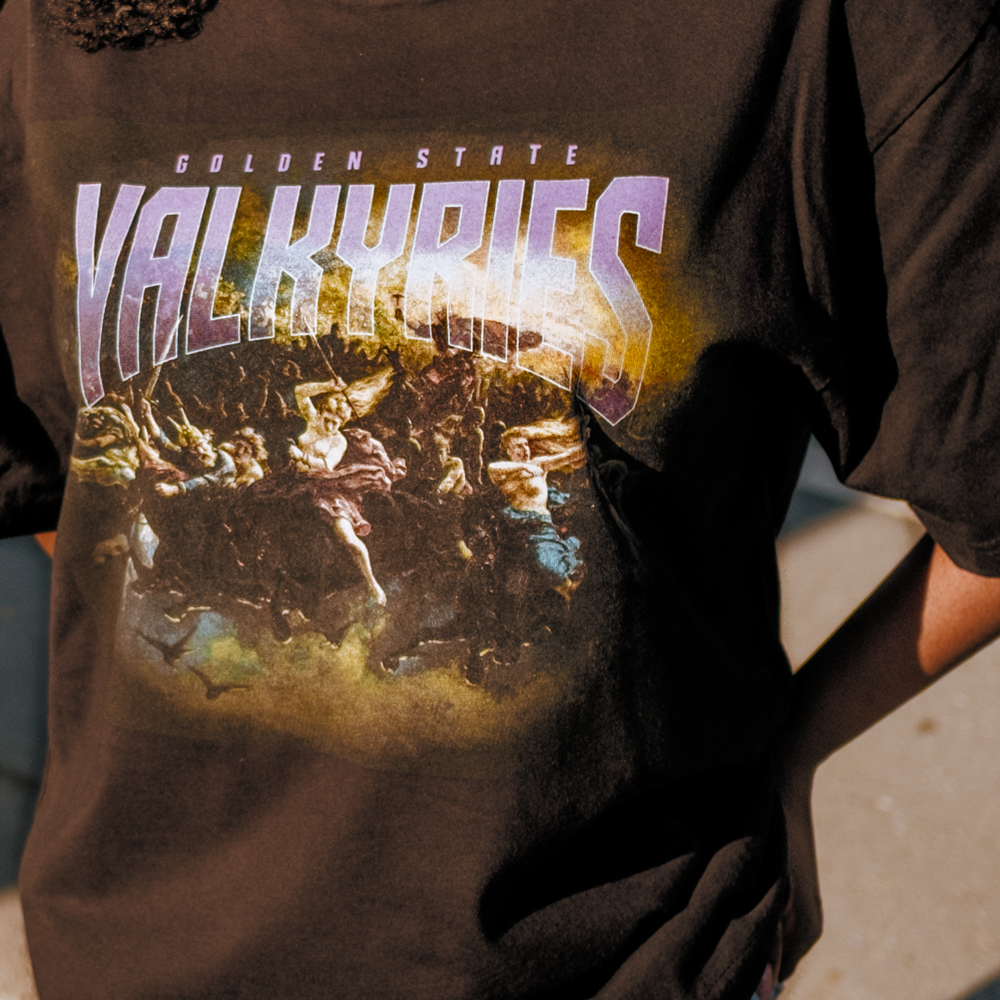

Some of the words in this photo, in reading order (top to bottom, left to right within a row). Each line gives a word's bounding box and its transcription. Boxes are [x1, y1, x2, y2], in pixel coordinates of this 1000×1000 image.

[175, 151, 362, 174] GOLDEN
[416, 144, 579, 169] STATE
[75, 175, 670, 427] VALKYRIES
